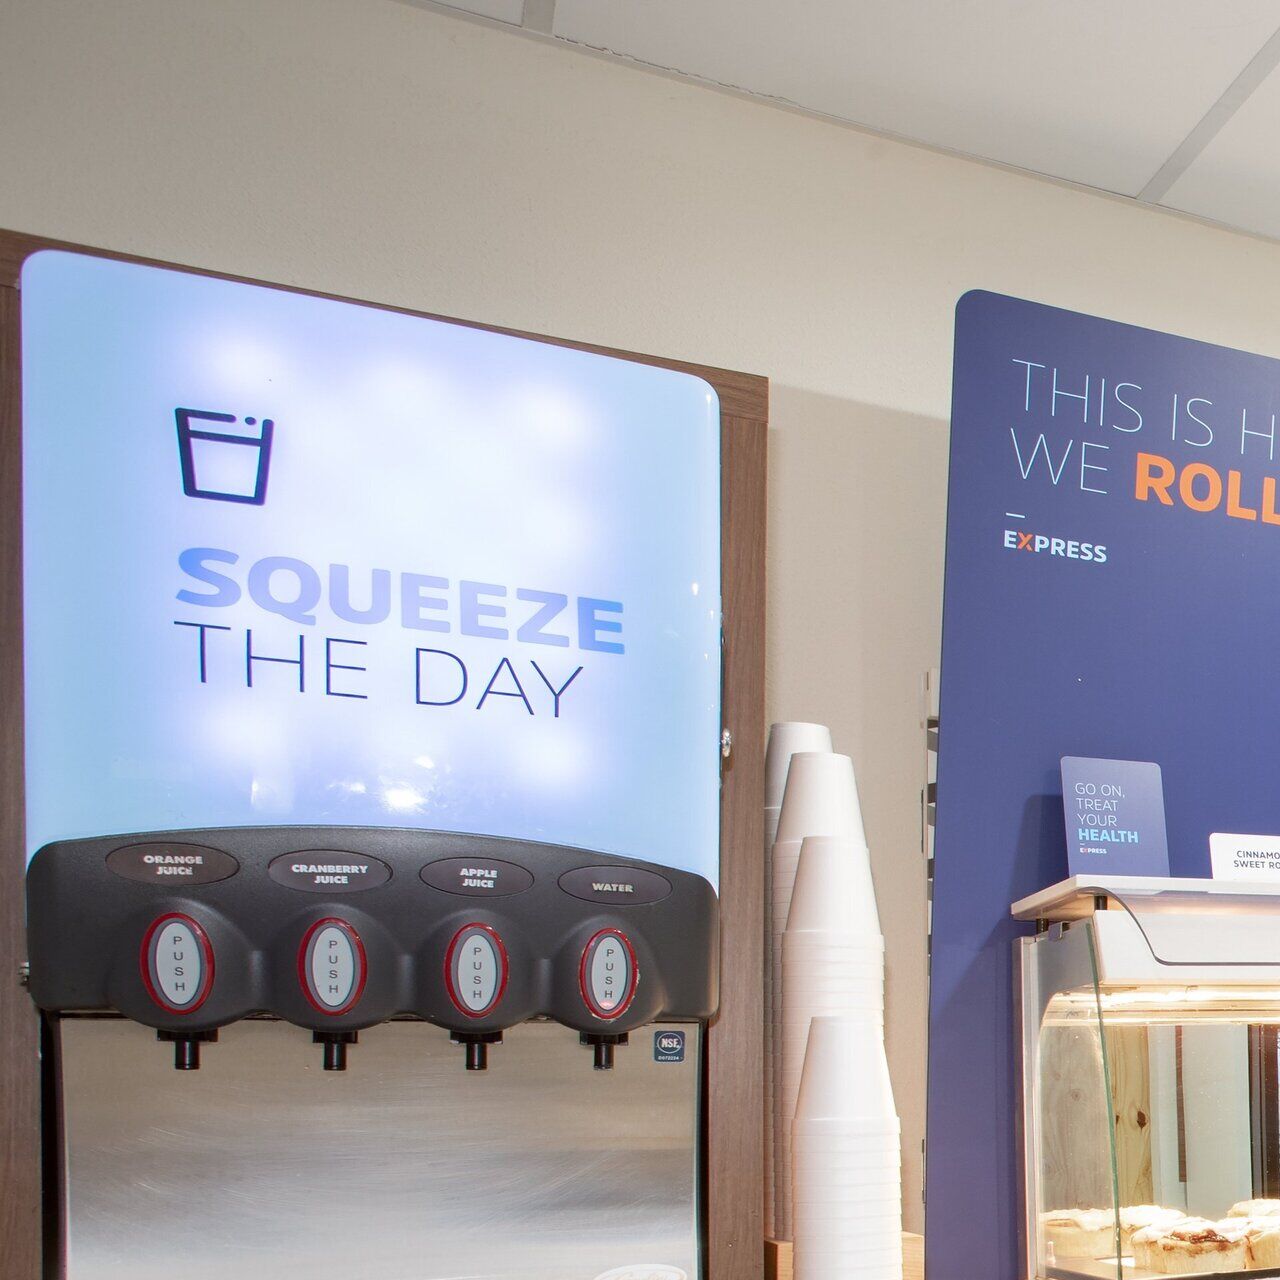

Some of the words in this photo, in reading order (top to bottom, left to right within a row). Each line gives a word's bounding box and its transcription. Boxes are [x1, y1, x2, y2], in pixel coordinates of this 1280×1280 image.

[1012, 358, 1143, 433] THIS
[1172, 394, 1214, 447] IS
[1011, 427, 1109, 494] WE
[1003, 529, 1107, 563] EXPRESS
[175, 546, 625, 655] SQUEEZE
[173, 620, 368, 699] THE
[415, 647, 584, 718] DAY
[1075, 782, 1096, 795] GO
[1100, 784, 1125, 798] ON,
[1076, 798, 1118, 811] TREAT
[1077, 813, 1117, 827] YOUR
[1078, 828, 1139, 844] HEALTH
[144, 855, 203, 865] ORANGE
[1233, 860, 1266, 869] SWEET
[156, 866, 193, 876] JUICE
[292, 864, 369, 874] CRANBERRY
[460, 868, 498, 878] APPLE
[314, 875, 348, 884] JUICE
[462, 878, 494, 888] JUICE
[592, 882, 634, 893] WATER
[173, 936, 186, 992] PUSH
[328, 940, 339, 994] PUSH
[473, 947, 482, 999] PUSH
[604, 948, 615, 999] PUSH
[661, 1037, 678, 1048] NSF
